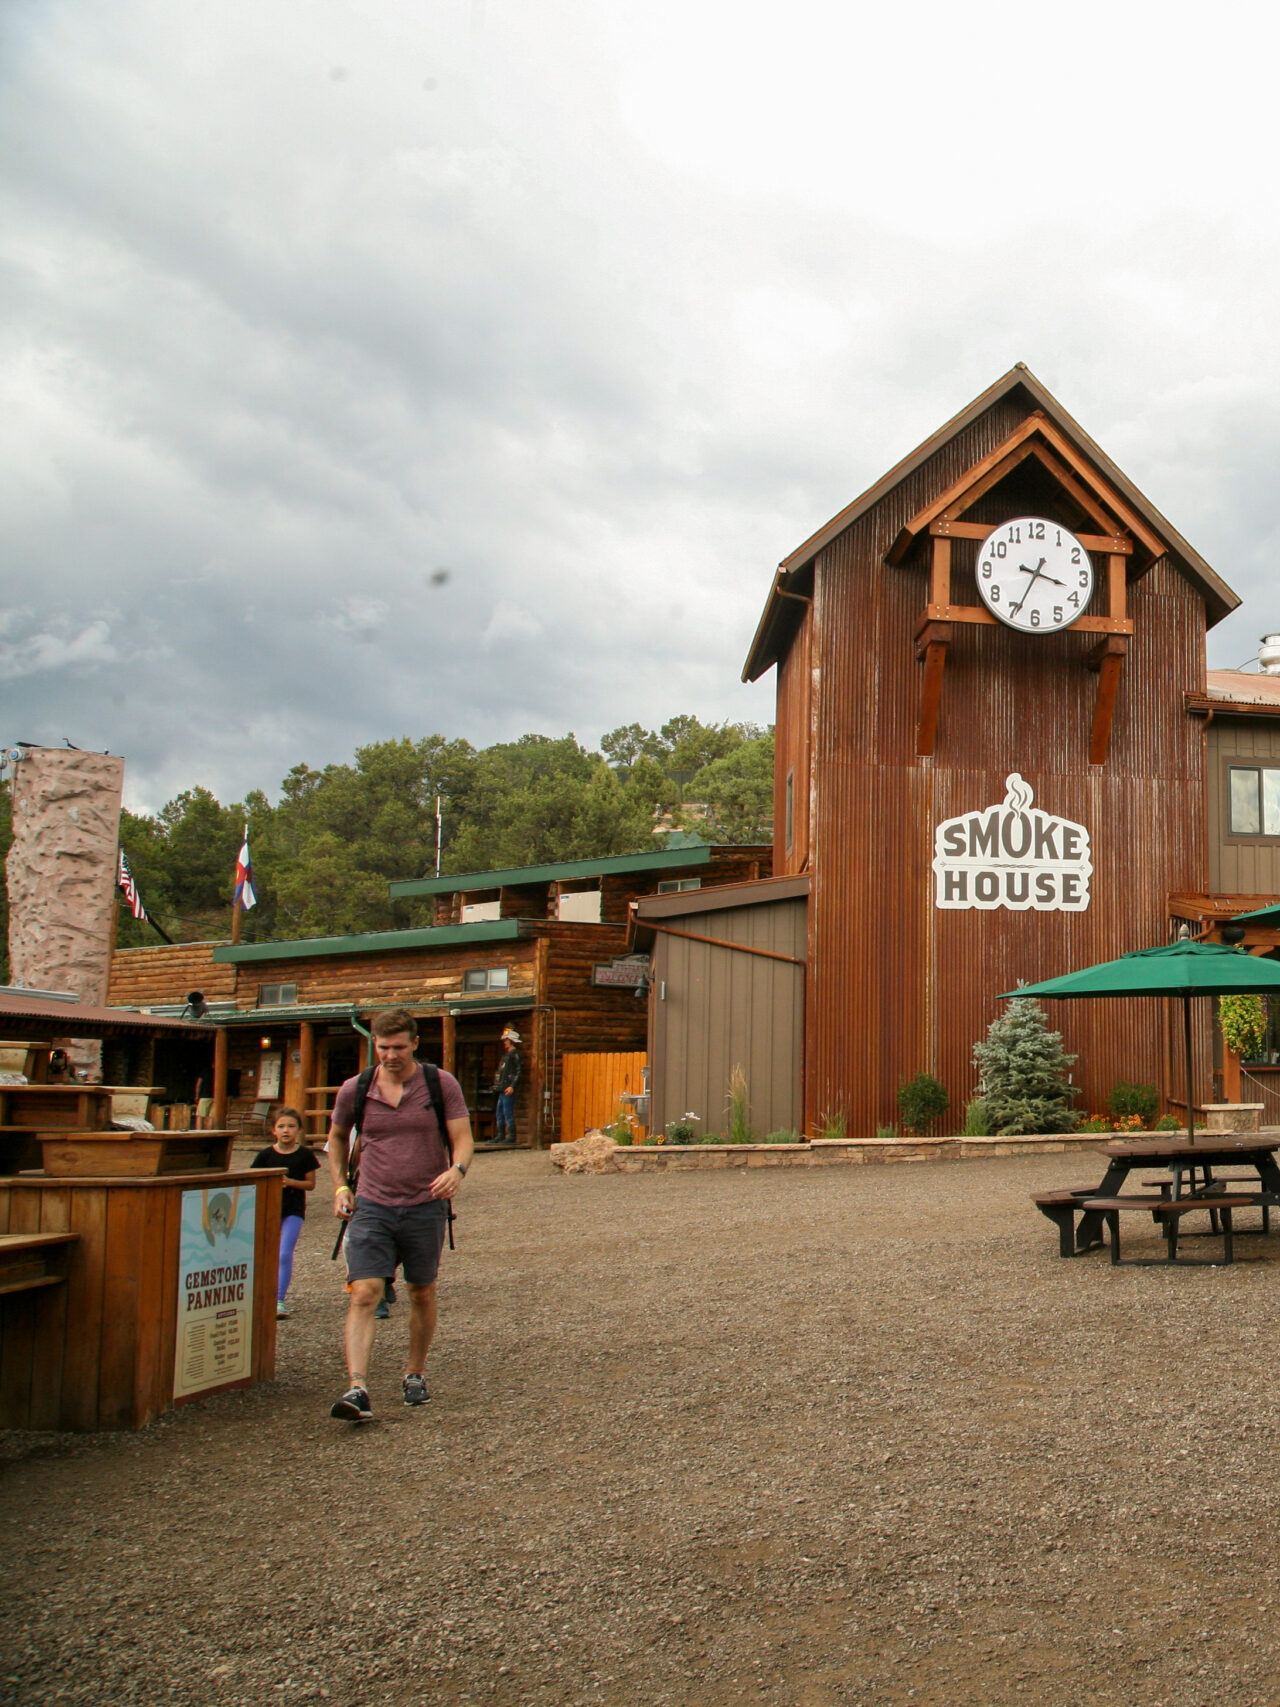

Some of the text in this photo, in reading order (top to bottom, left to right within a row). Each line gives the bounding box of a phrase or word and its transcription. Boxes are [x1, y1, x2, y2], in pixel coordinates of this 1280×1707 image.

[1008, 526, 1021, 544] 11
[1028, 522, 1045, 540] 12
[1056, 530, 1062, 547] 1
[990, 540, 1007, 558] 10
[1071, 547, 1081, 564] 2
[982, 561, 992, 579] 9
[1079, 570, 1088, 588] 3
[990, 584, 1000, 602] 8
[1067, 590, 1079, 608] 4
[1008, 601, 1019, 619] 7
[1030, 609, 1040, 627] 6
[1053, 605, 1063, 623] 5
[943, 811, 1082, 860] SMOKE
[944, 870, 1082, 904] HOUSE
[185, 1263, 248, 1290] GEMSTONE
[187, 1283, 245, 1312] PANNING
